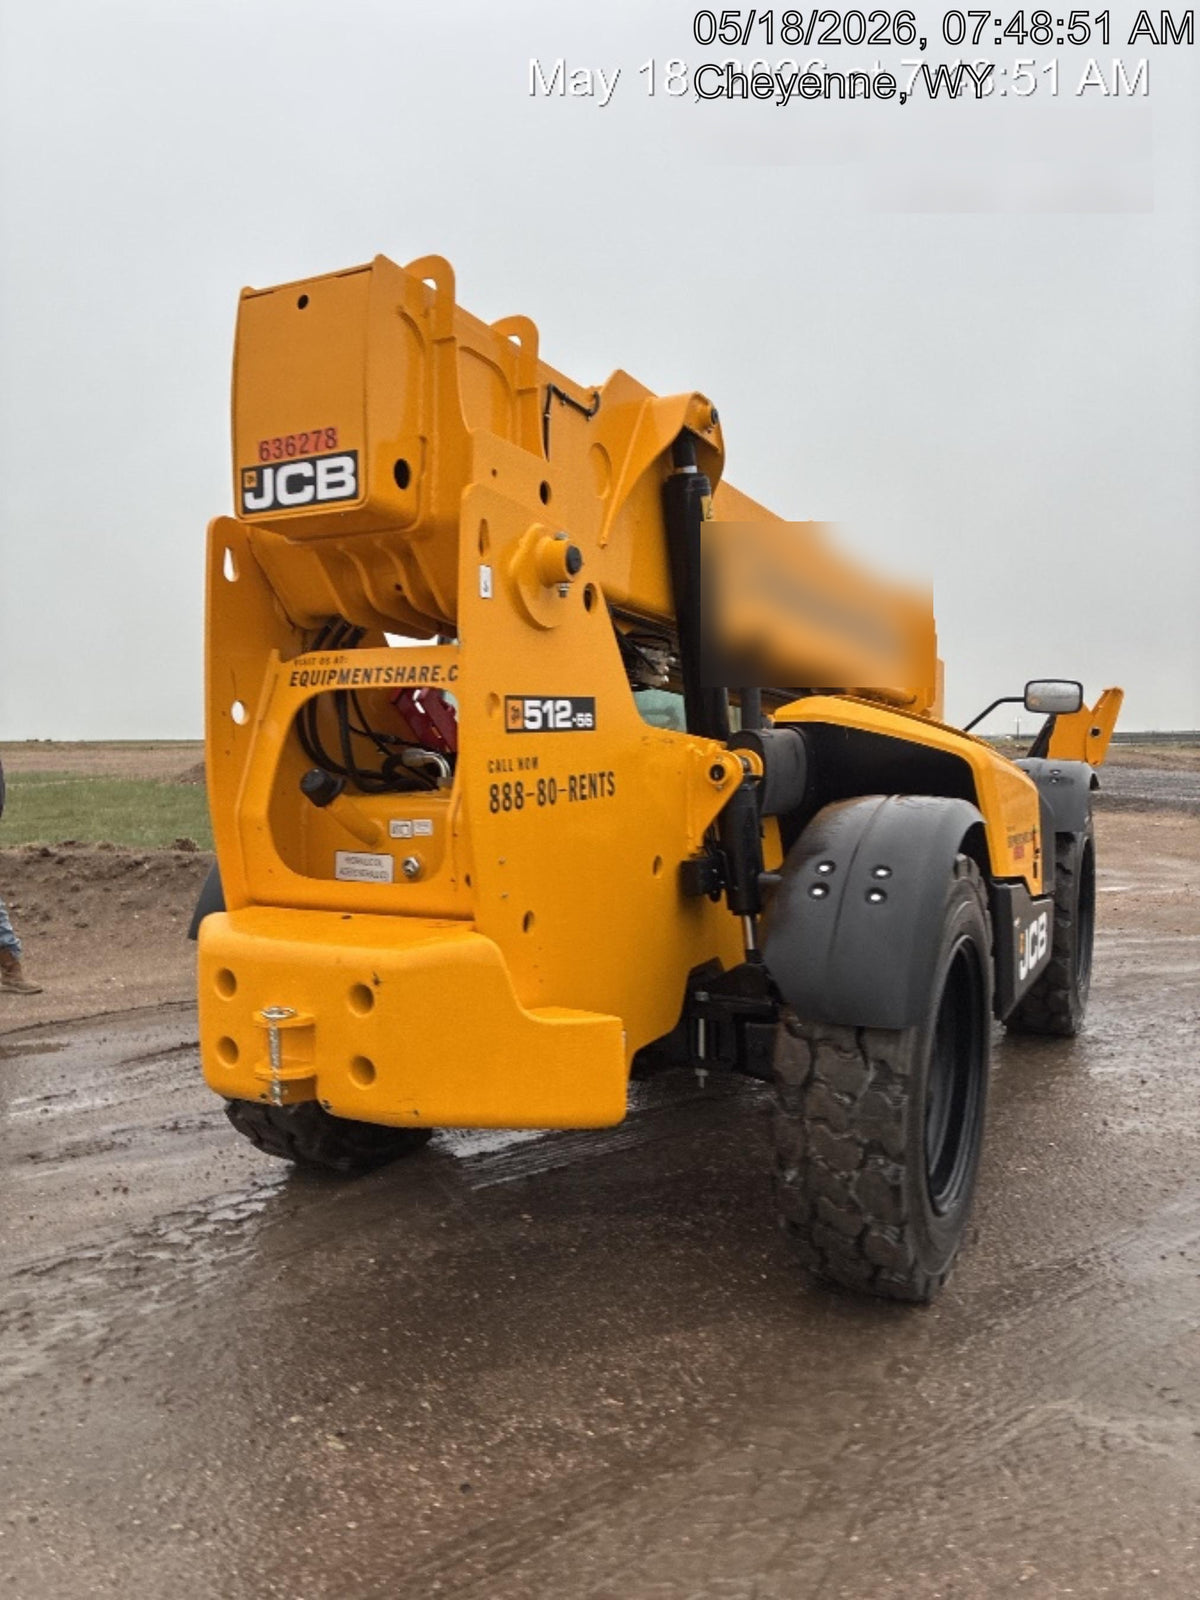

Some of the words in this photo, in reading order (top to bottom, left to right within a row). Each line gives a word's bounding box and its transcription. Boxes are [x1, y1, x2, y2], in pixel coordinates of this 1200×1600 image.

[259, 427, 338, 462] 636278
[243, 455, 357, 510] JCB
[488, 758, 514, 774] CALL
[518, 756, 539, 771] NOW
[489, 771, 616, 814] 888-80-RENTS
[1020, 911, 1049, 981] JCB
